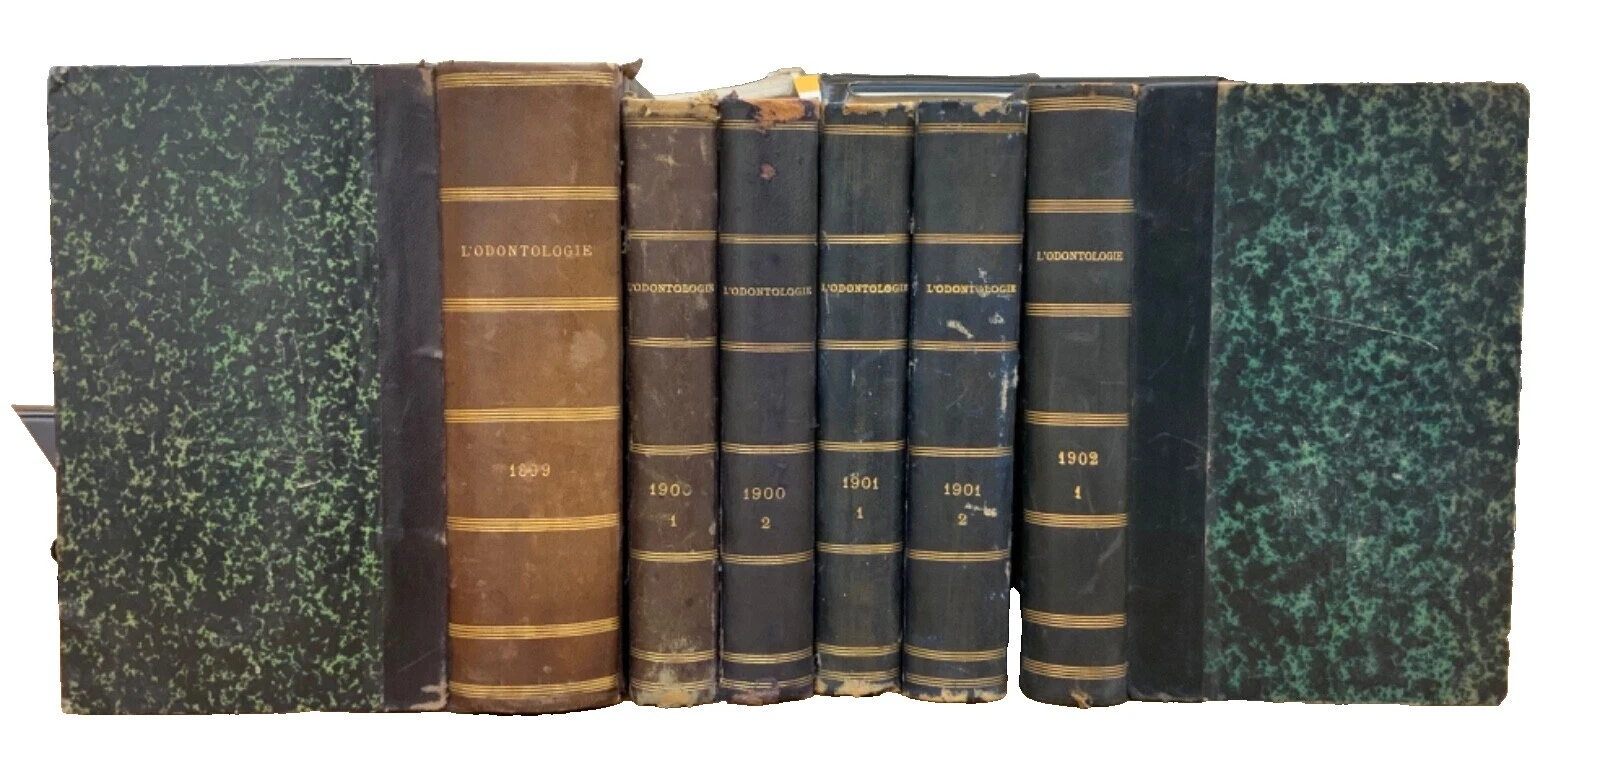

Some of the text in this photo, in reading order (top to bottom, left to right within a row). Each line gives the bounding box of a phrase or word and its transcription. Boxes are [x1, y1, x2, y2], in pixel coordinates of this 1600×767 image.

[461, 244, 593, 258] L'ODONTOLOGIE
[1036, 251, 1124, 262] L'ODONTOLOGIE
[1057, 451, 1099, 466] 1902
[842, 475, 880, 490] 1901
[743, 487, 786, 500] 1900
[943, 483, 981, 497] 1901
[1073, 485, 1082, 499] 1
[856, 506, 864, 519] 1
[957, 513, 968, 526] 2
[670, 514, 678, 527] 1
[760, 516, 771, 530] 2
